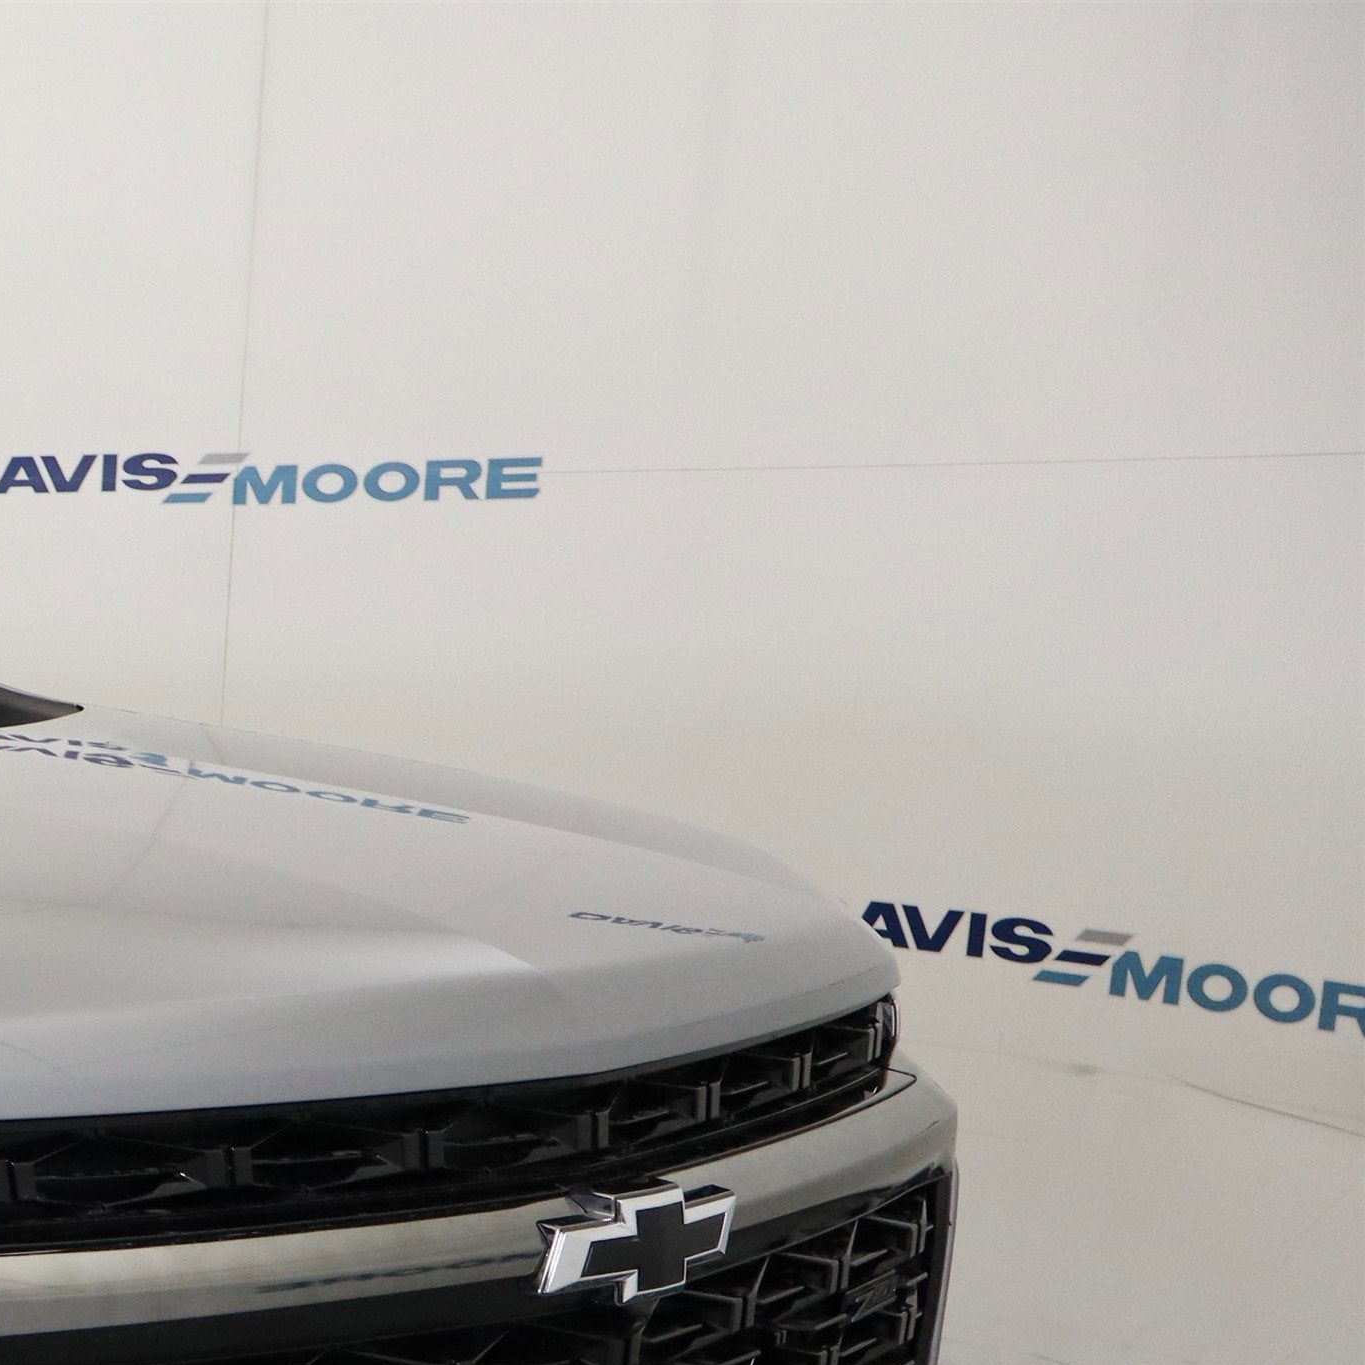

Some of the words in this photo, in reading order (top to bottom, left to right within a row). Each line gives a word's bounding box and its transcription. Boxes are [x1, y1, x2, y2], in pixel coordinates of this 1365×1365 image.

[232, 457, 543, 505] MOORE
[862, 900, 1054, 964] AVIS
[1109, 950, 1365, 1038] MOOR
